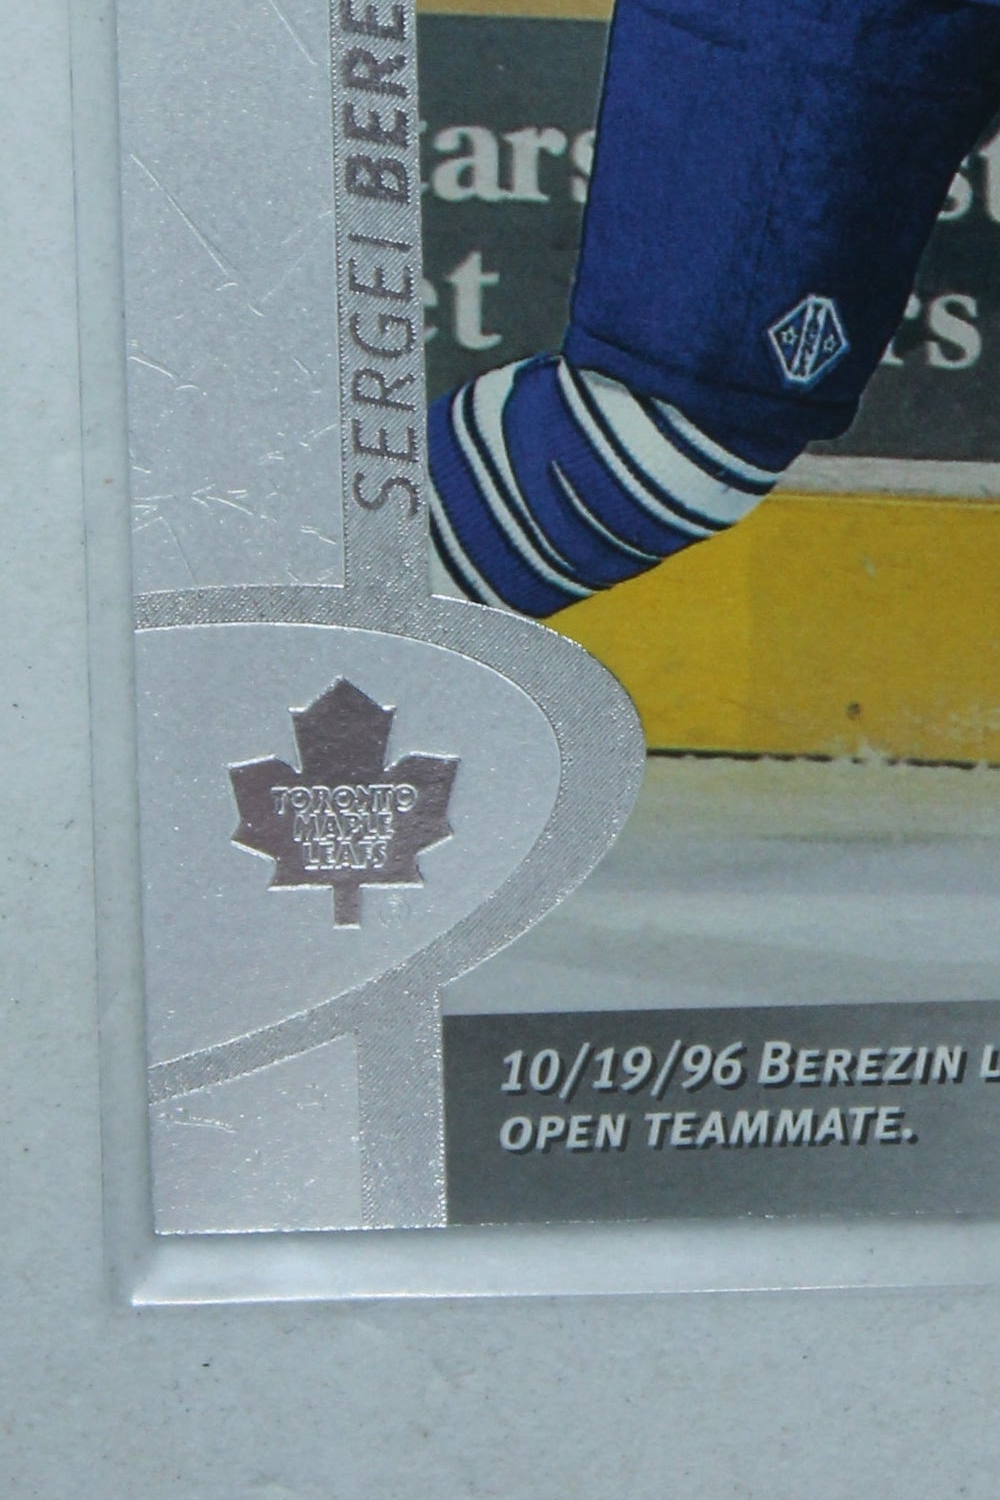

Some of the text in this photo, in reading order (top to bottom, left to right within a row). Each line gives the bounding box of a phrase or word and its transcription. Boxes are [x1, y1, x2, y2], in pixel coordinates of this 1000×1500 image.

[350, 233, 420, 516] SERGEI
[270, 783, 419, 816] TORONTO
[293, 811, 396, 842] MAPLE
[302, 840, 388, 871] LEAFS
[500, 1040, 749, 1100] 10/19/96
[757, 1041, 967, 1087] BEREZIN
[500, 1106, 918, 1153] OPEN TEAMMATE.
